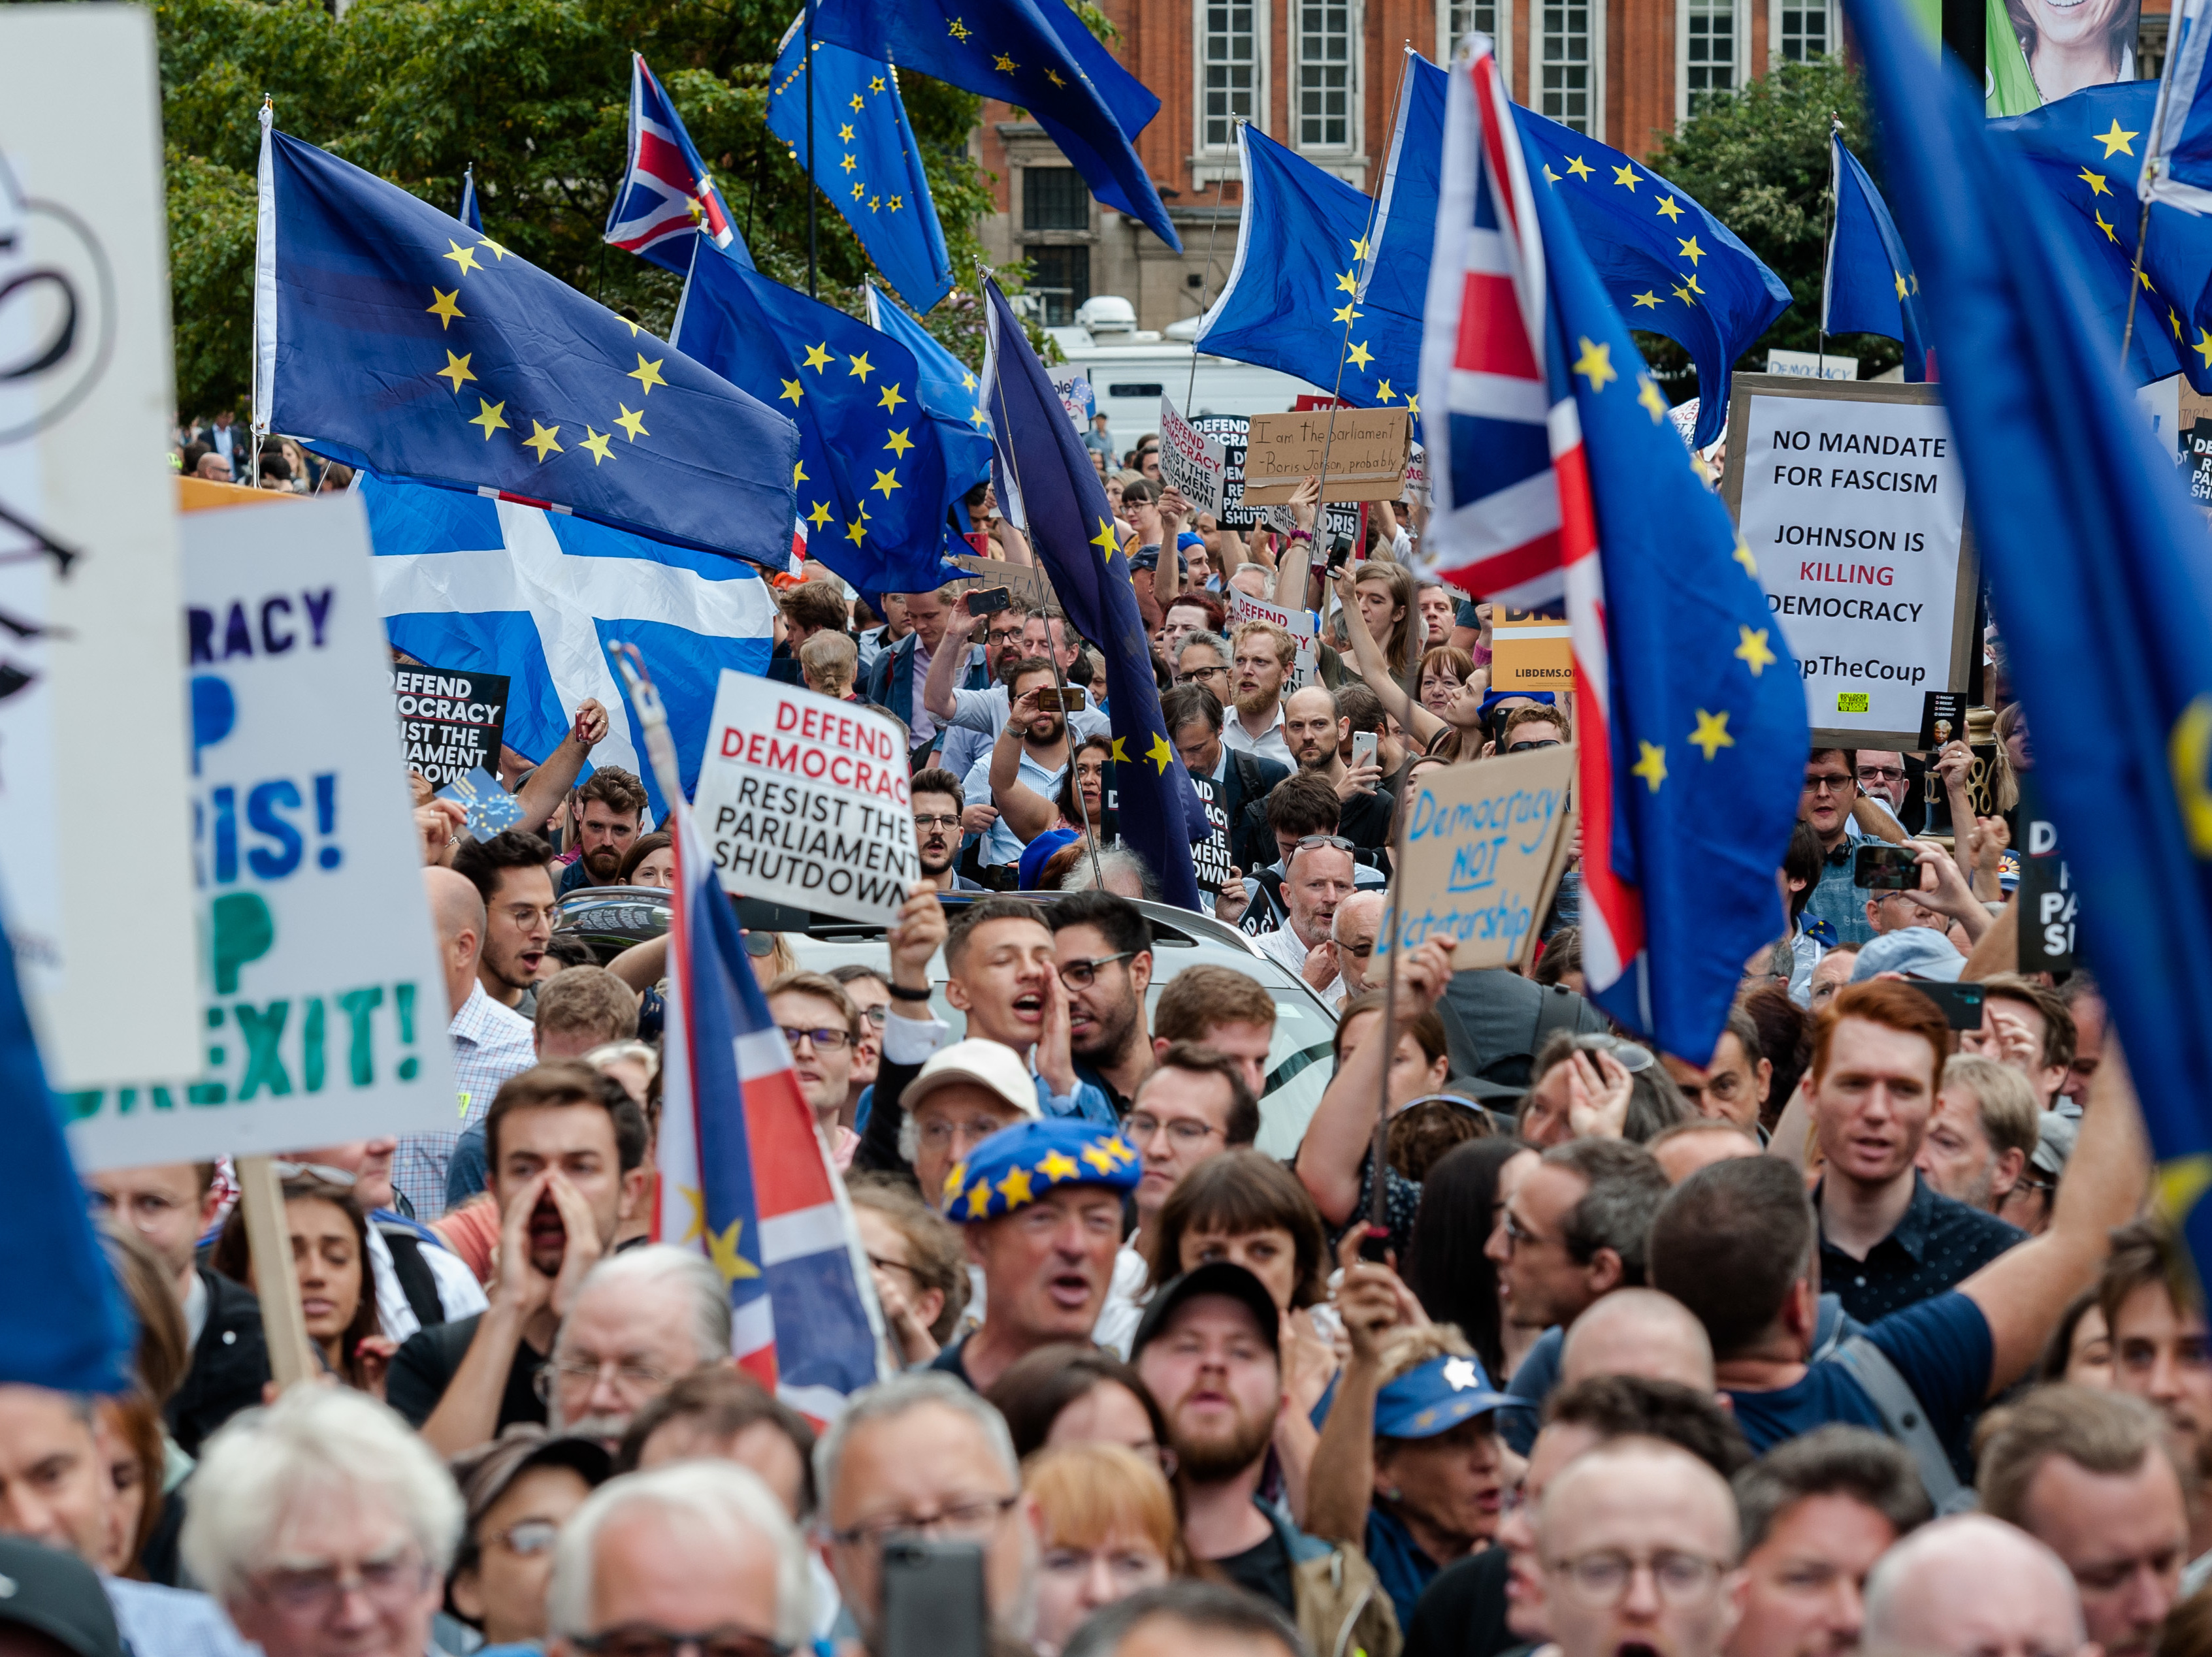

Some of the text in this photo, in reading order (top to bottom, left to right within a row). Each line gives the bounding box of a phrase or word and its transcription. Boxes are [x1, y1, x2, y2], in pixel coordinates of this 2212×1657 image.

[1162, 413, 1221, 474] DEMOCRACY
[1171, 411, 1205, 451] DEFEND
[1192, 418, 1250, 434] DEFEND
[1276, 434, 1293, 444] am
[1300, 419, 1325, 443] the
[1165, 436, 1186, 469] RESIST
[1188, 461, 1211, 485] THE
[1350, 449, 1396, 474] probably
[1773, 430, 1947, 458] NO MANDATE
[1162, 443, 1216, 498] PARLIAMENT
[1162, 458, 1213, 510] SHUTDOWN
[1774, 465, 1938, 494] FOR FASCISM
[1774, 524, 1925, 553] JOHNSON IS
[1800, 562, 1895, 587] KILLING
[1239, 598, 1288, 628] DEFEND
[1766, 594, 1924, 622] DEMOCRACY
[440, 726, 480, 747] THE
[776, 700, 892, 762] DEFEND
[739, 777, 909, 846] RESIST THE
[1408, 788, 1563, 855] Democracy
[715, 841, 907, 908] SHUTDOWN
[1447, 835, 1509, 883] NOT
